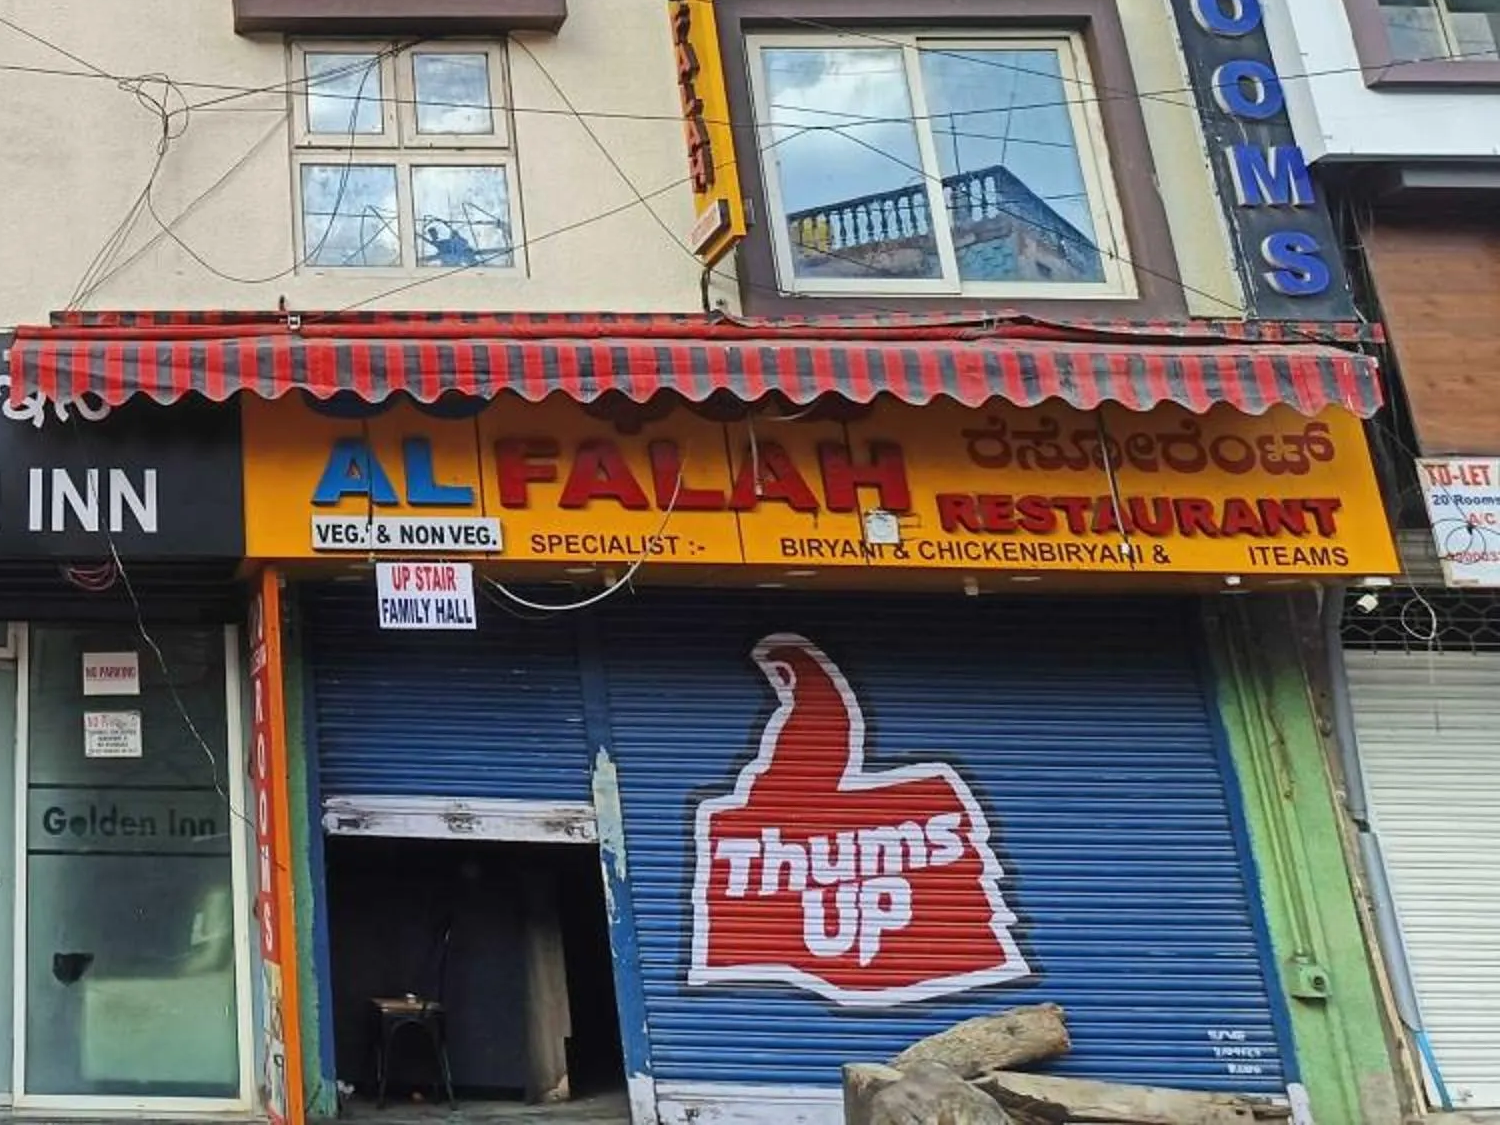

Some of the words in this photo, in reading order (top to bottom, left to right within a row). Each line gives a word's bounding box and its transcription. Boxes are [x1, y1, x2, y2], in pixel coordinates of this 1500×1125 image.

[29, 468, 158, 533] INN
[310, 436, 475, 506] AL
[494, 437, 911, 512] FALAH
[936, 493, 1342, 538] RESTAURANT
[377, 524, 391, 544] &
[401, 525, 445, 545] NON
[449, 526, 497, 546] VEG.
[531, 534, 679, 556] SPECIALIST
[780, 538, 884, 559] BIRYANI
[893, 542, 911, 560] &
[1153, 544, 1172, 565] &
[1249, 545, 1349, 567] ITEAMS
[391, 566, 410, 591] UP
[415, 566, 457, 592] STAIR
[381, 598, 431, 624] FAMILY
[435, 598, 473, 624] HALL
[42, 806, 157, 837] Golden
[254, 679, 274, 952] ROOMS
[713, 812, 972, 897] Thums
